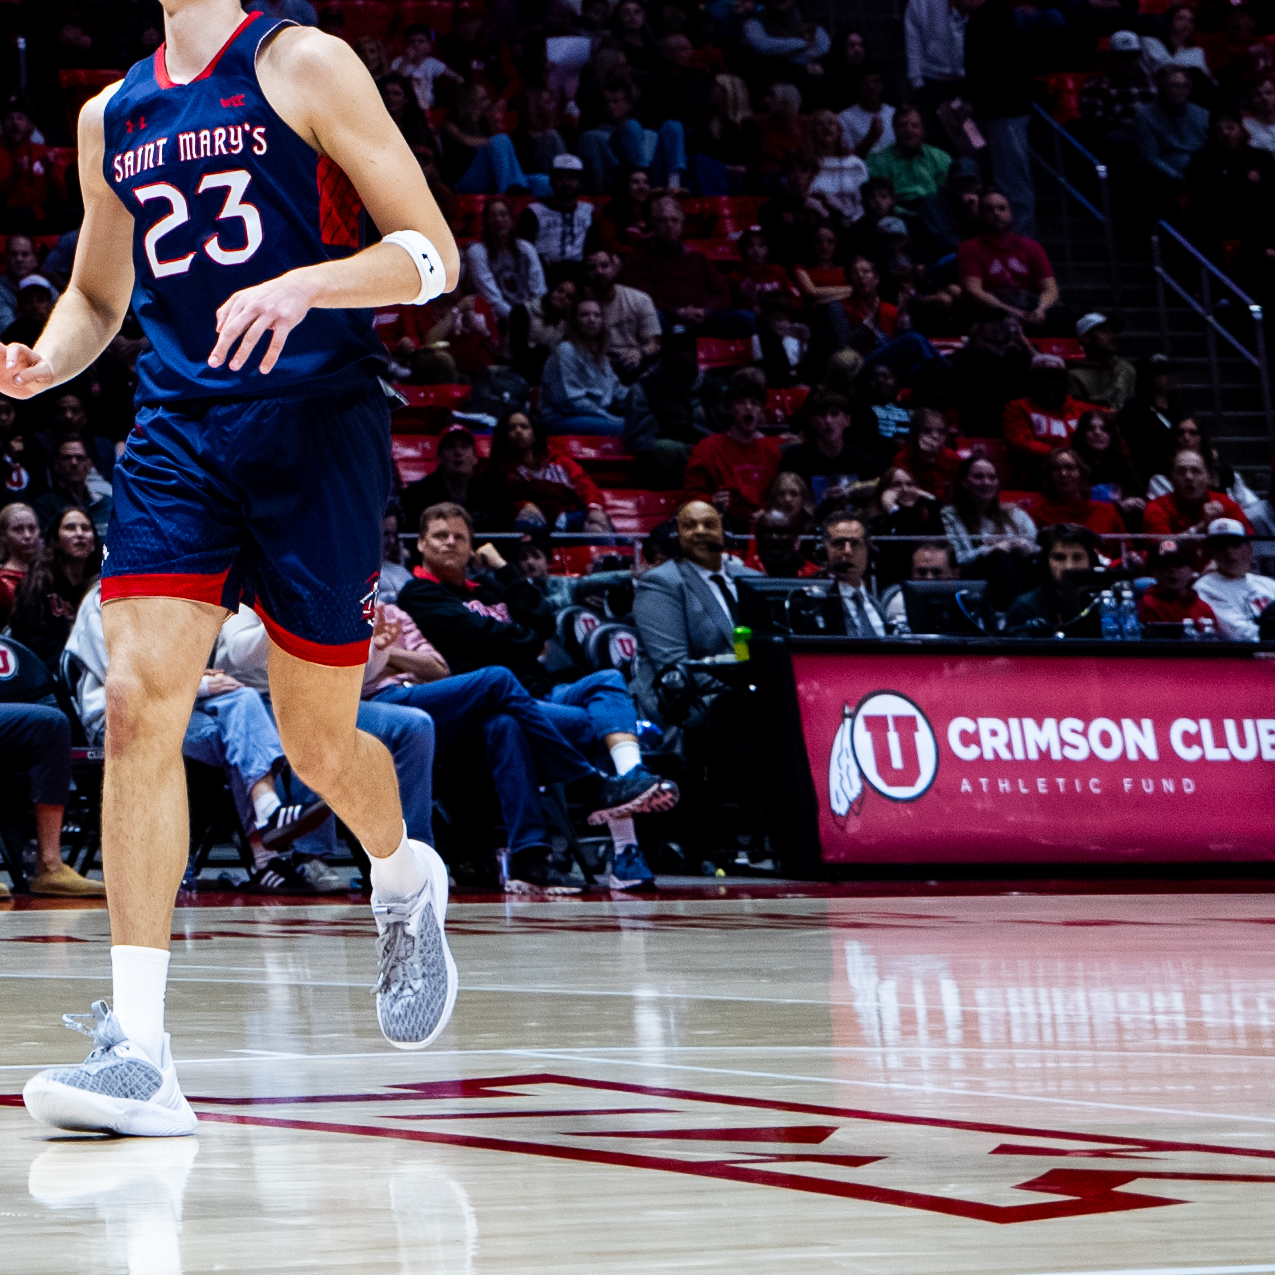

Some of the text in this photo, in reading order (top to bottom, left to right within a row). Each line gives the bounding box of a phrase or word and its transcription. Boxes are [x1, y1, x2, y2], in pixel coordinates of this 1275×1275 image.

[113, 122, 268, 183] SAINT MARY'S
[132, 169, 264, 279] 23
[948, 716, 1159, 762] CRIMSON
[960, 777, 1196, 794] ATHLETIC FUND
